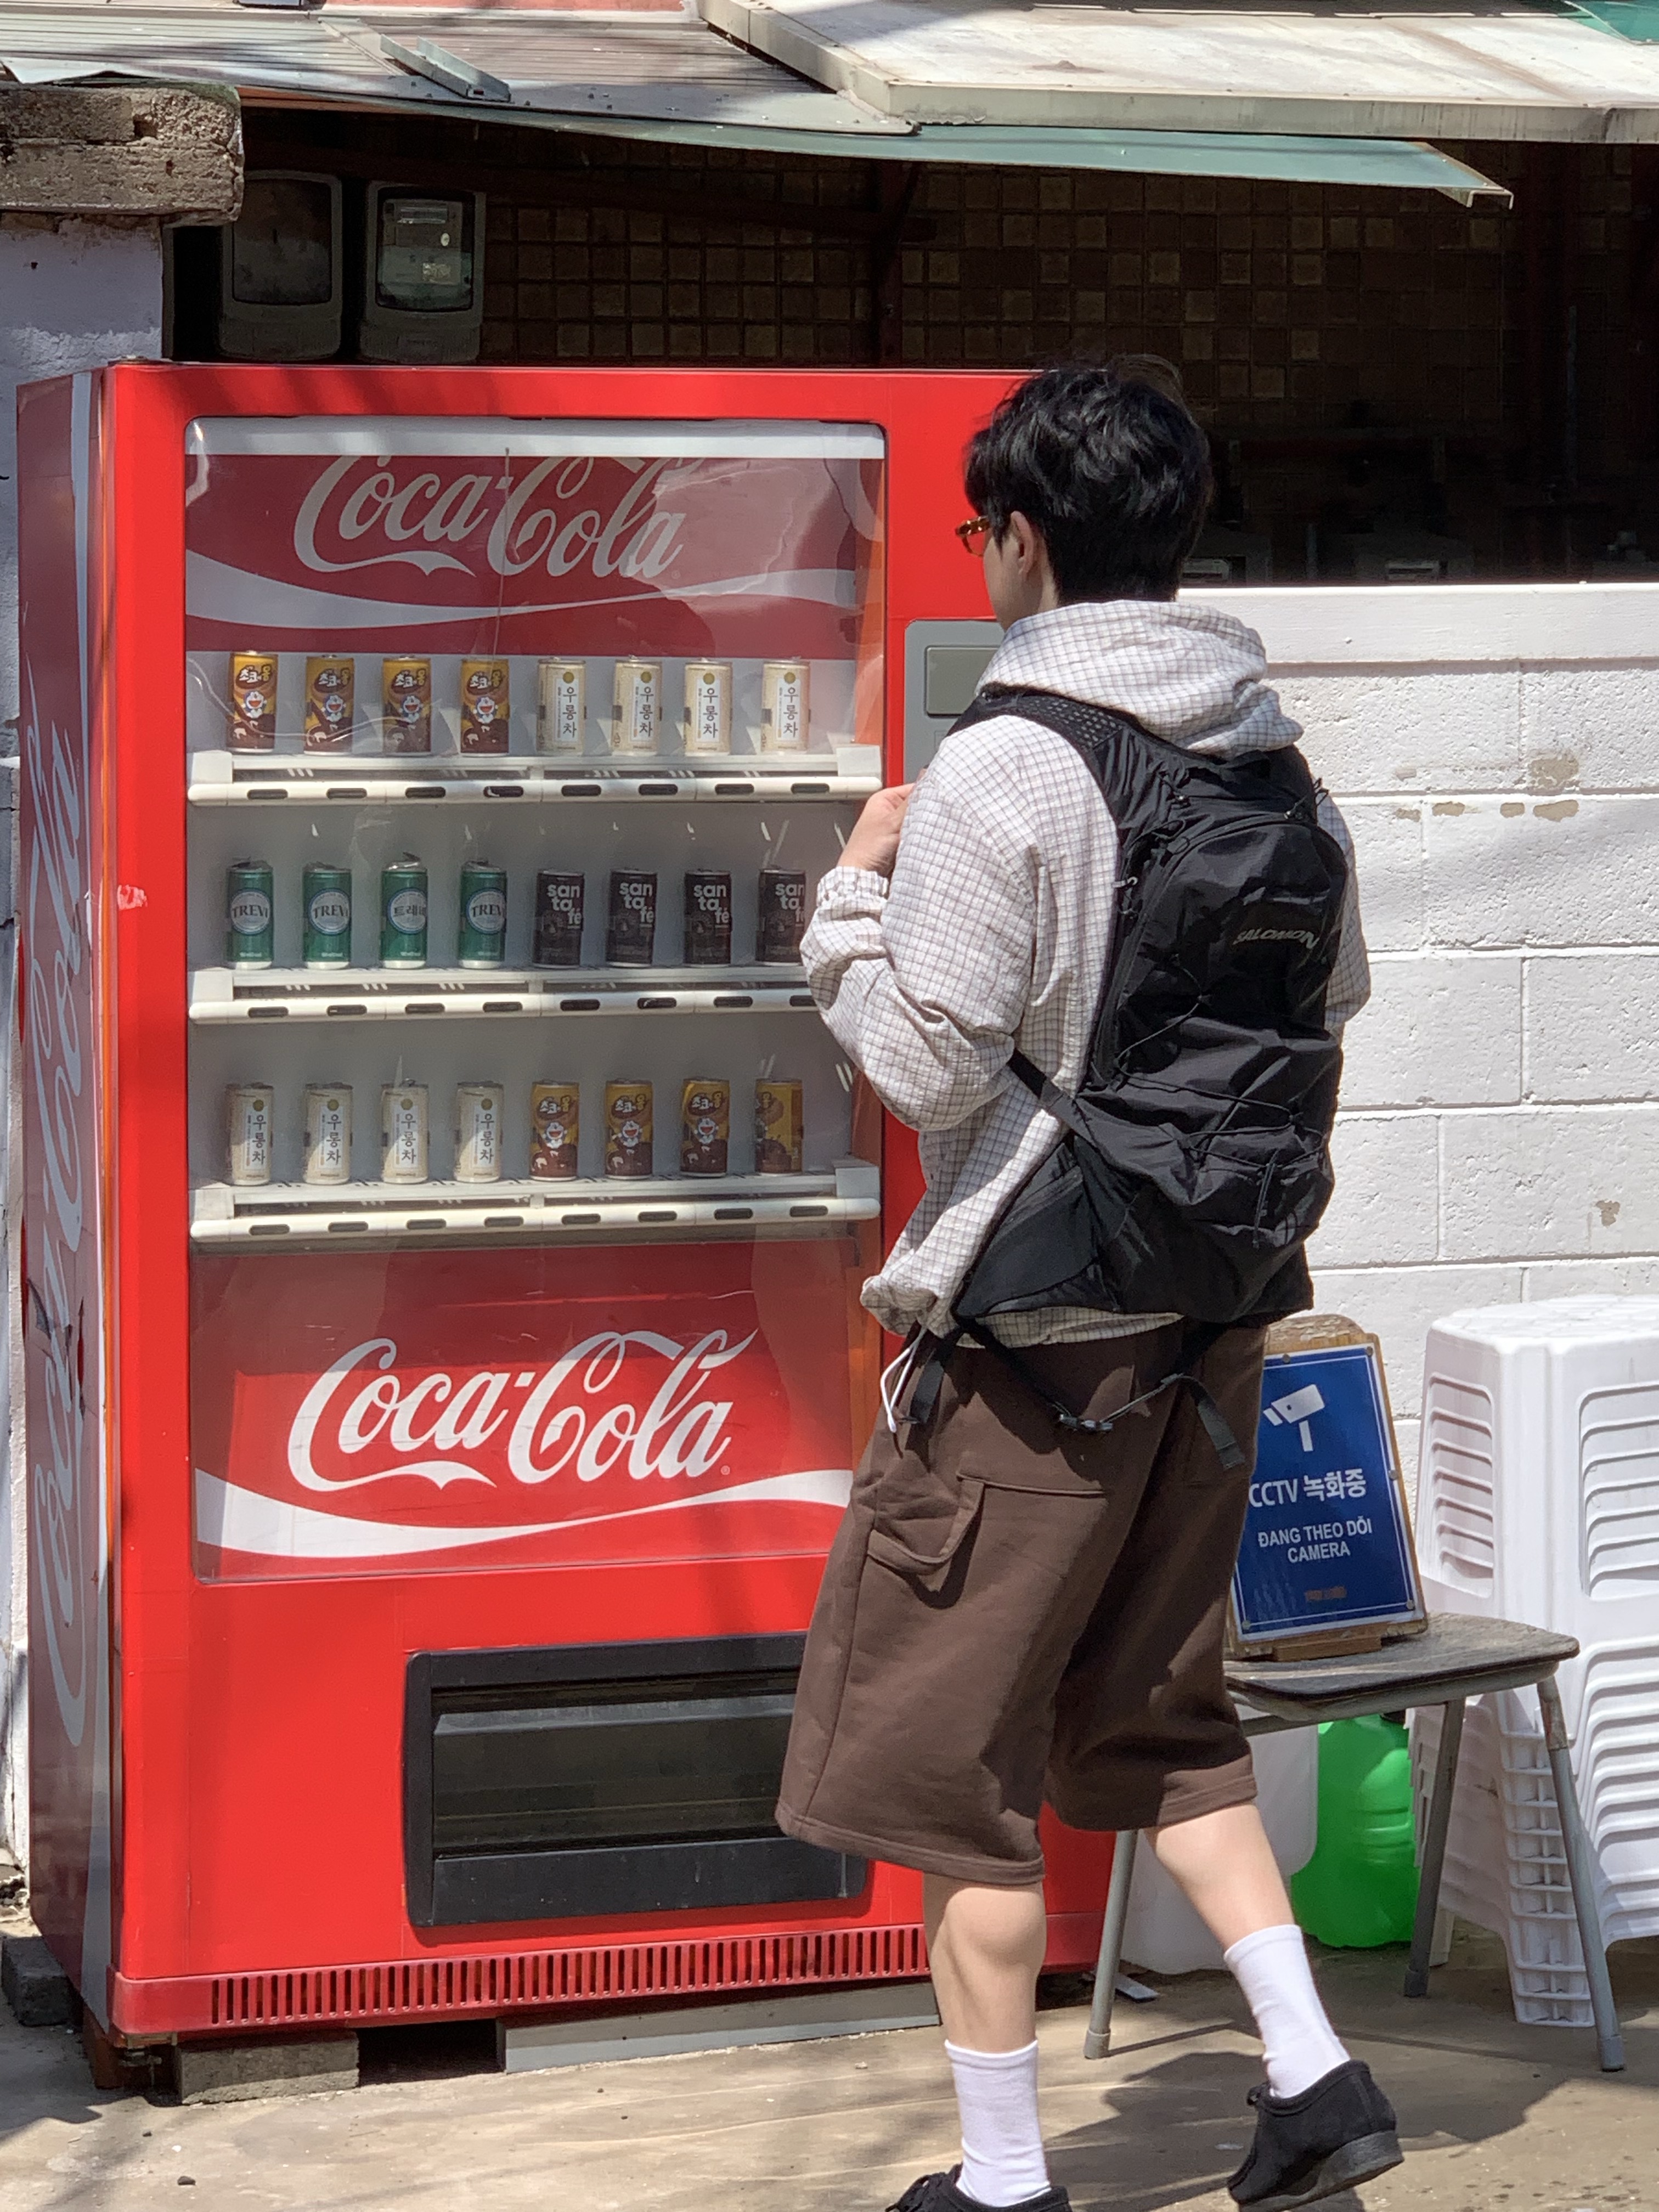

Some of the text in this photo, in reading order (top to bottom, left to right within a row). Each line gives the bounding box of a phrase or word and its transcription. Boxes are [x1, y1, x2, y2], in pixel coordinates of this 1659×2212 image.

[294, 456, 705, 577] Coca-Cola
[562, 686, 577, 738] 우롱차
[639, 686, 654, 737] 우롱차
[703, 687, 718, 738] 우롱차
[783, 686, 799, 738] 우롱차
[232, 905, 268, 918] TREVI
[547, 884, 580, 898] san
[551, 896, 573, 911] ta
[619, 882, 653, 897] san
[623, 894, 645, 910] ta
[693, 884, 727, 898] san
[697, 896, 719, 911] ta
[780, 895, 799, 910] ta
[252, 1114, 267, 1165] 우롱차
[326, 1114, 341, 1165] 우롱차
[400, 1113, 416, 1164] 우롱차
[479, 1113, 494, 1164] 우롱차
[26, 652, 86, 1746] Coca-Cola
[287, 1327, 759, 1491] Coca-Cola
[1249, 1468, 1367, 1508] CCTV 녹화중
[1257, 1515, 1373, 1548] ĐANG THEO DÕI
[1287, 1541, 1351, 1564] CAMERA
